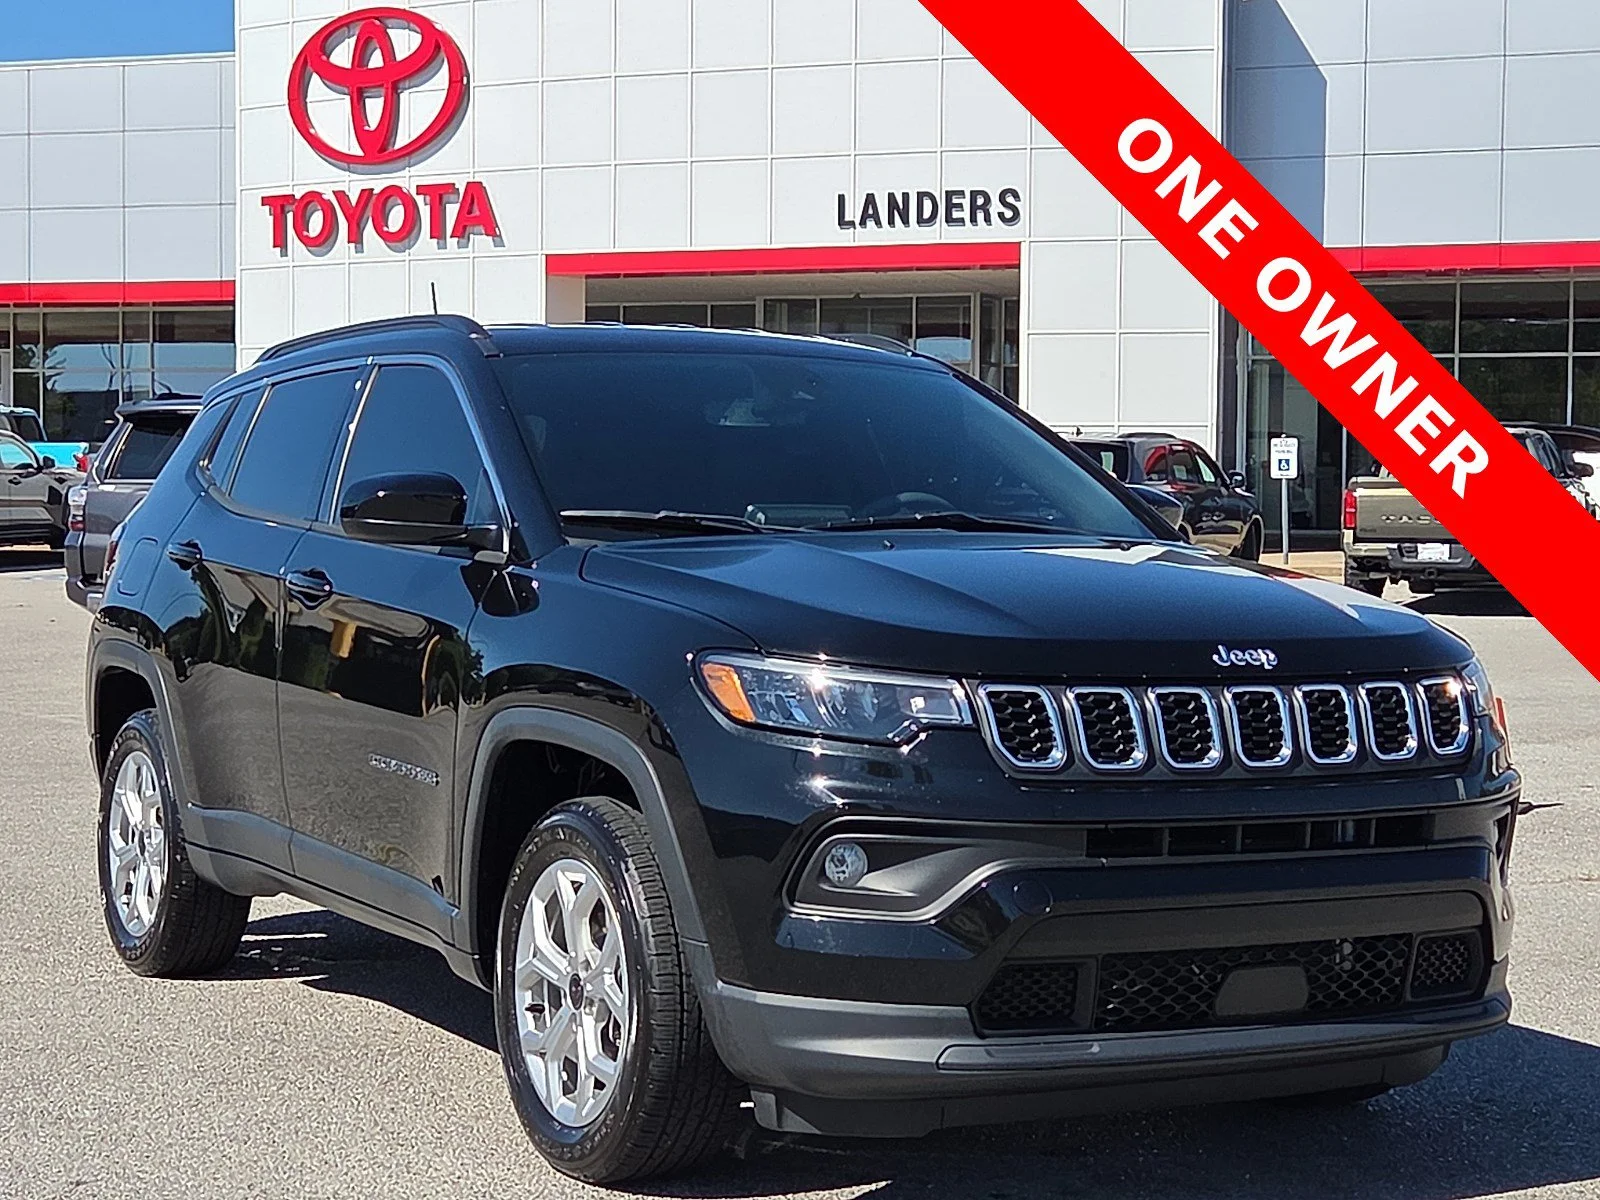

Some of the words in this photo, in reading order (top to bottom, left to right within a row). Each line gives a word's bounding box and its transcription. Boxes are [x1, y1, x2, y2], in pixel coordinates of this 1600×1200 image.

[261, 181, 502, 255] TOYOTA
[837, 187, 1022, 230] LANDERS
[1212, 644, 1278, 670] Jeep
